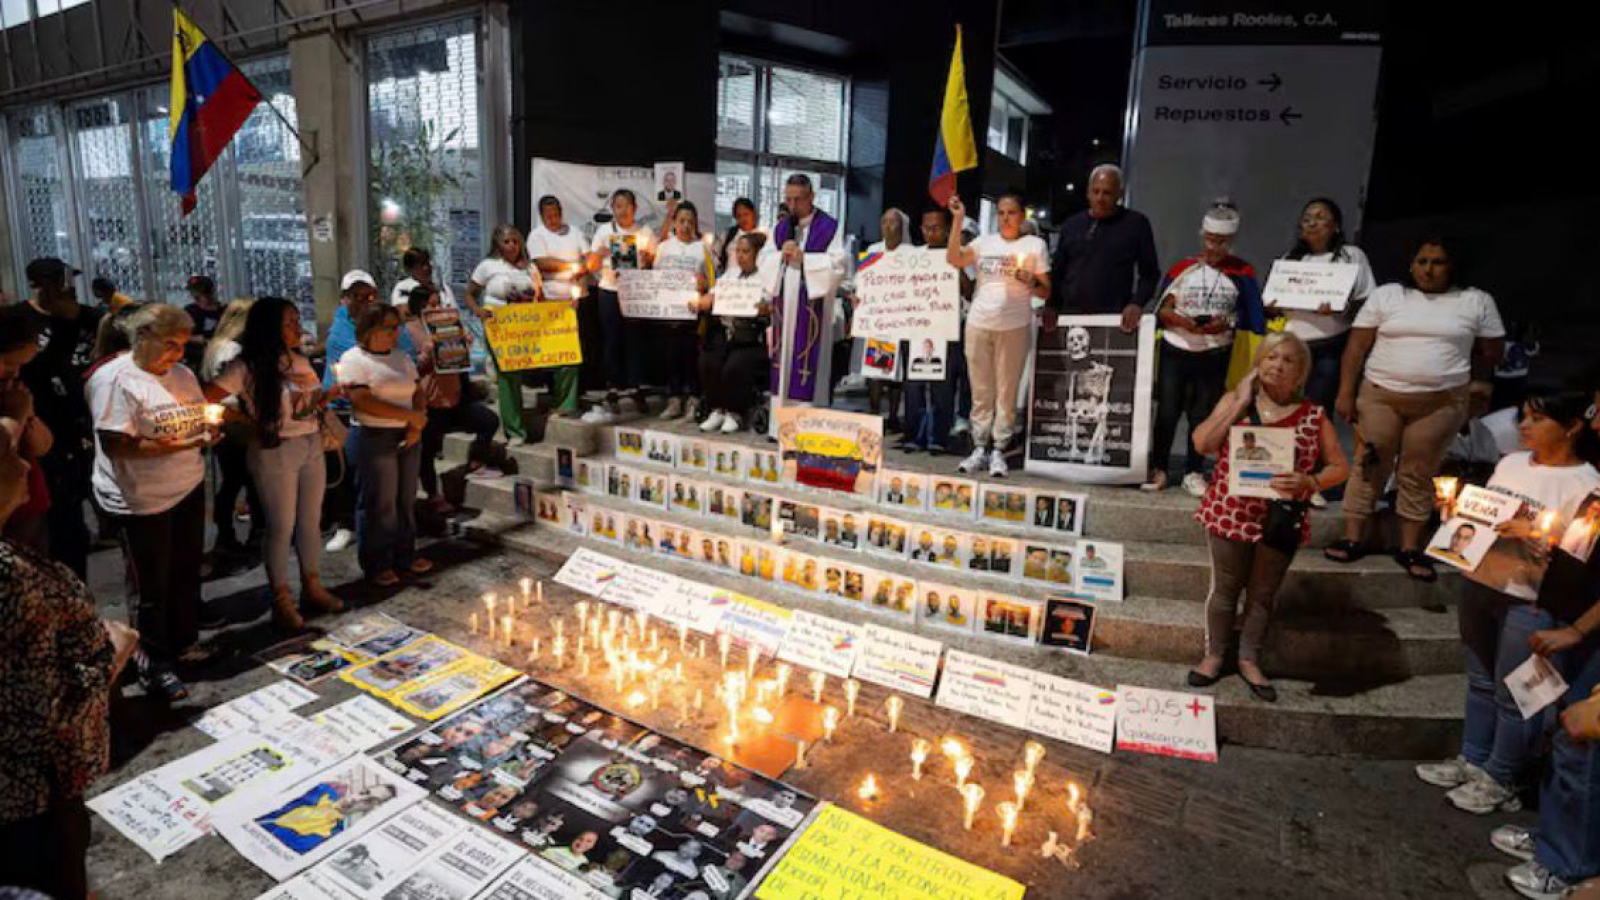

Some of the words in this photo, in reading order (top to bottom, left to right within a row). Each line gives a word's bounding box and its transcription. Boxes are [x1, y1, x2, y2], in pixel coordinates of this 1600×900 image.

[1163, 13, 1228, 27] Talleres
[1304, 13, 1337, 26] C.A.
[1158, 74, 1246, 91] Servicio
[1154, 106, 1271, 123] Repuestos
